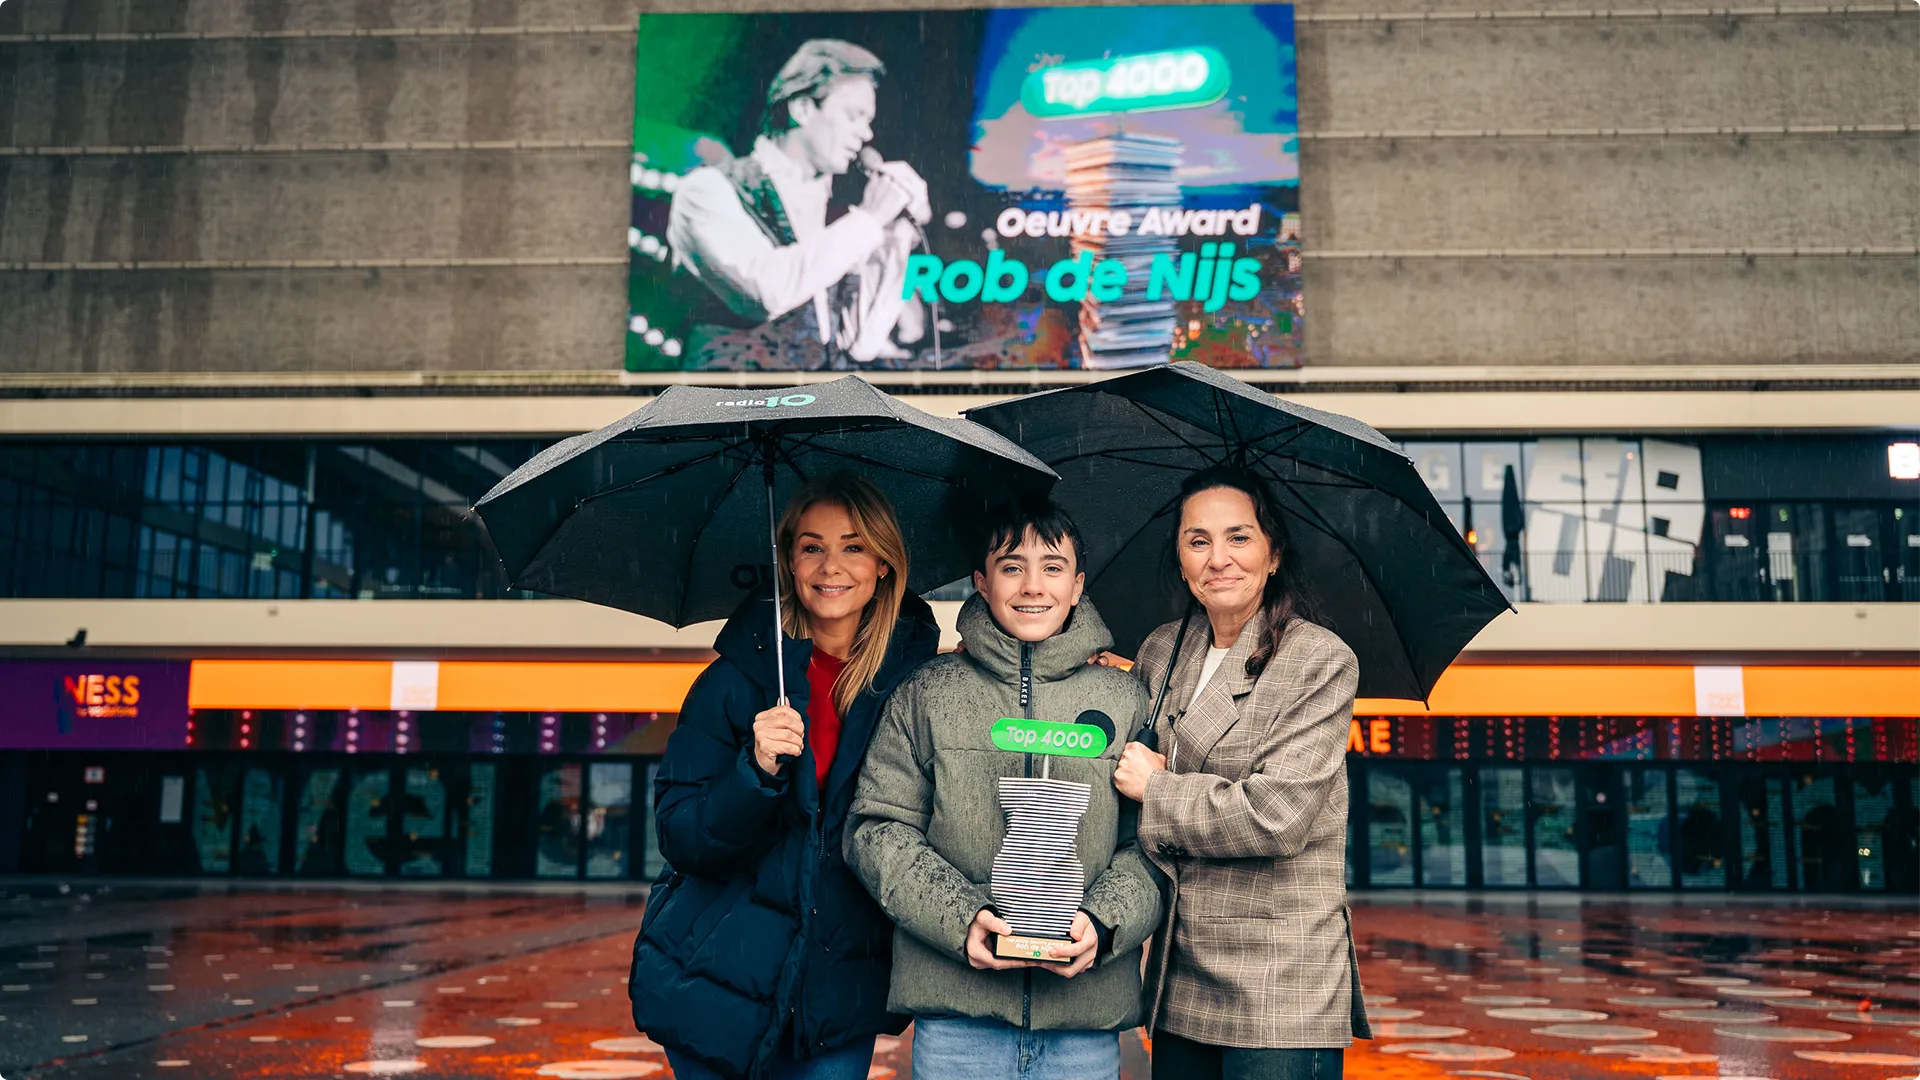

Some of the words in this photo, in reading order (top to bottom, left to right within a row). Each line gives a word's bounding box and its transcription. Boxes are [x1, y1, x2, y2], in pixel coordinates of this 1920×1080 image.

[1042, 68, 1101, 108] Top
[1106, 51, 1209, 98] 4000
[997, 207, 1132, 237] Oeuvre
[1137, 203, 1262, 236] Award
[902, 249, 1029, 303] Rob
[1045, 250, 1129, 302] de
[1146, 242, 1263, 313] Nijs
[1020, 676, 1029, 704] BAKER
[1006, 726, 1037, 748] Top
[1041, 729, 1093, 749] 4000
